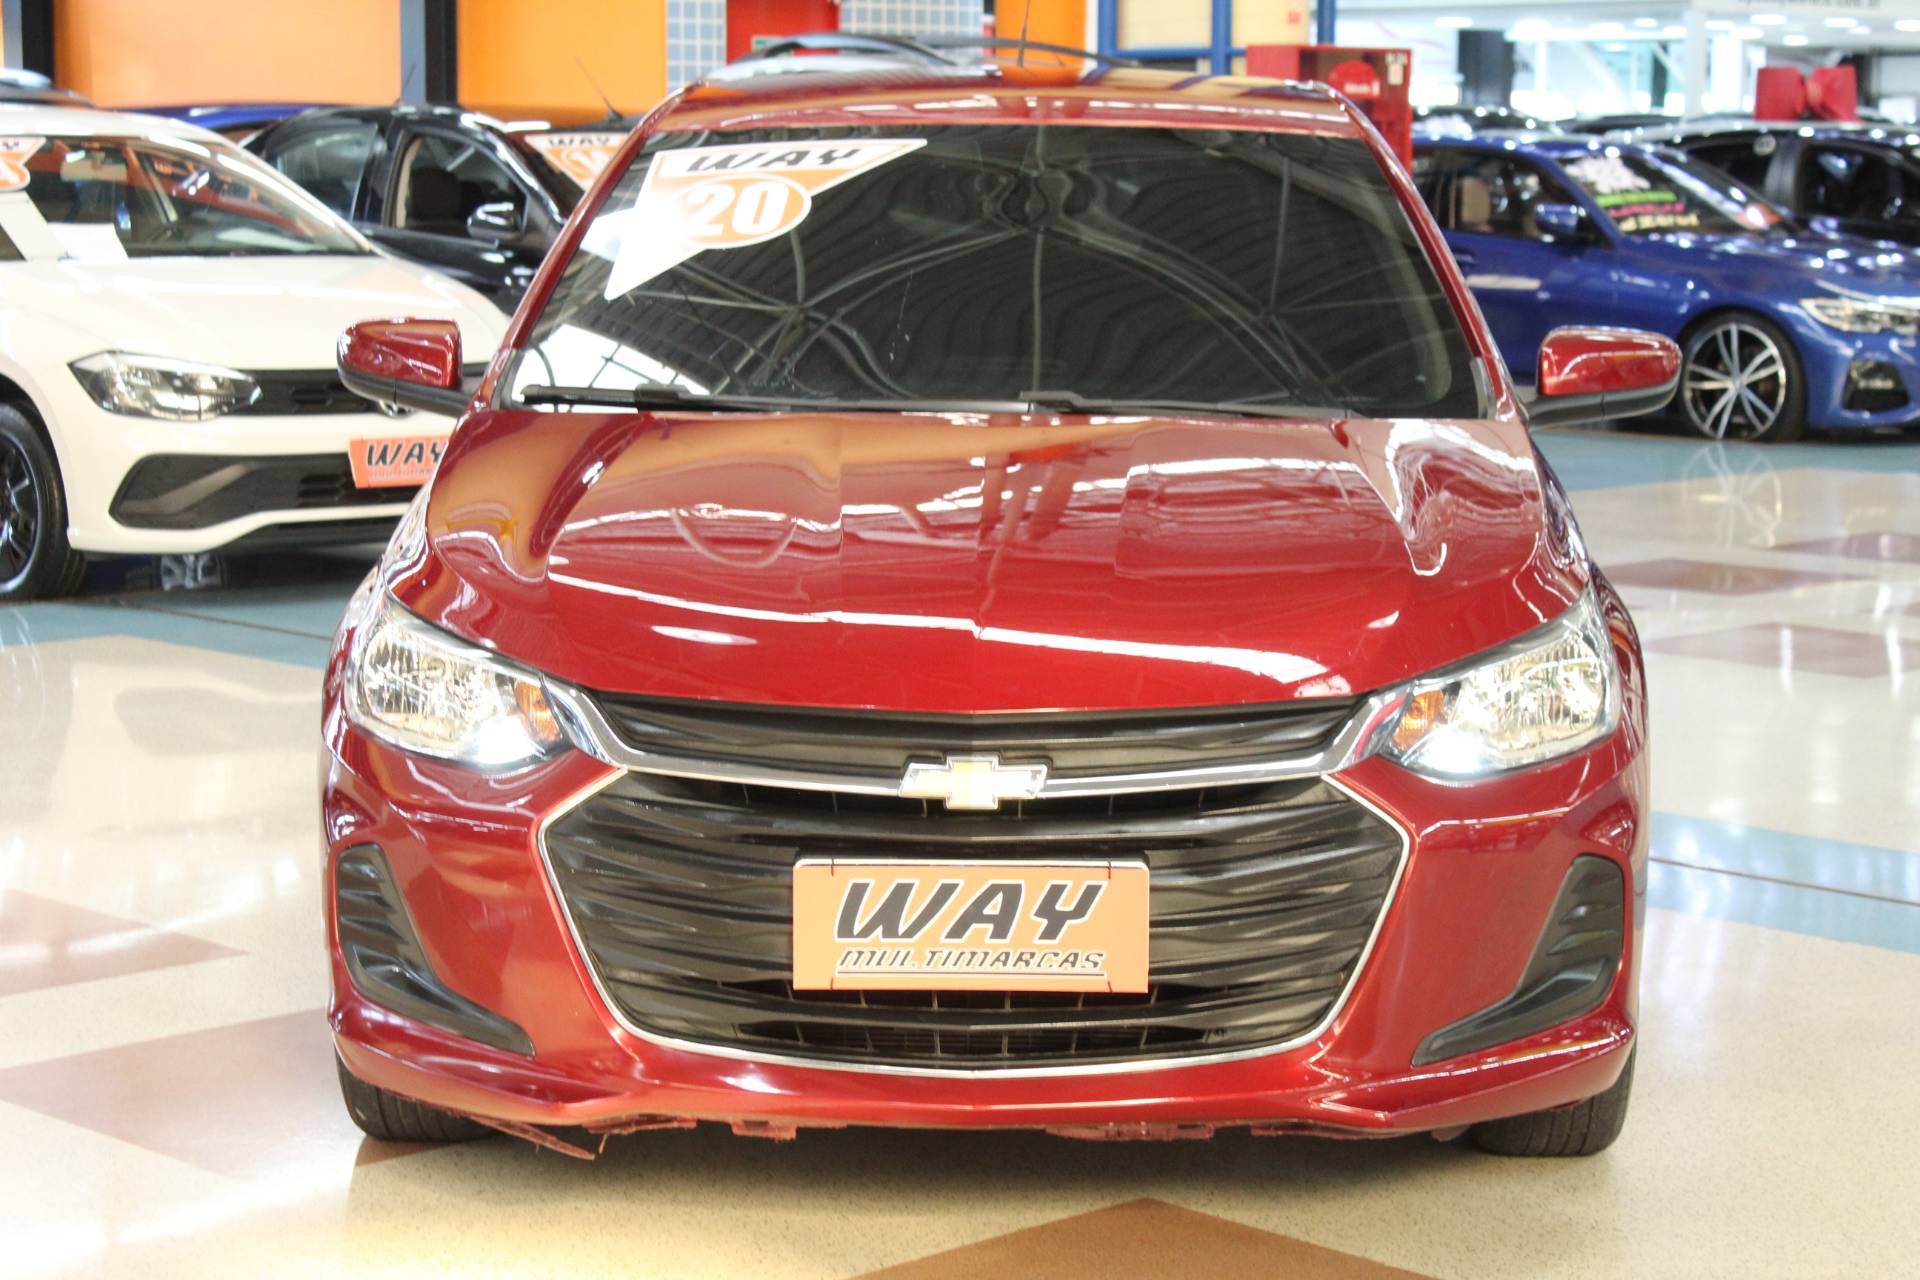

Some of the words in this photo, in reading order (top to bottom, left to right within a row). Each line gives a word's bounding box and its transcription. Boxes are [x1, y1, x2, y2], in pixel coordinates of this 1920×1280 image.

[686, 149, 862, 172] WAY
[687, 181, 790, 236] 20
[366, 441, 448, 466] WAY
[835, 878, 1108, 944] WAY
[839, 949, 1105, 970] MULTIMARCAS
